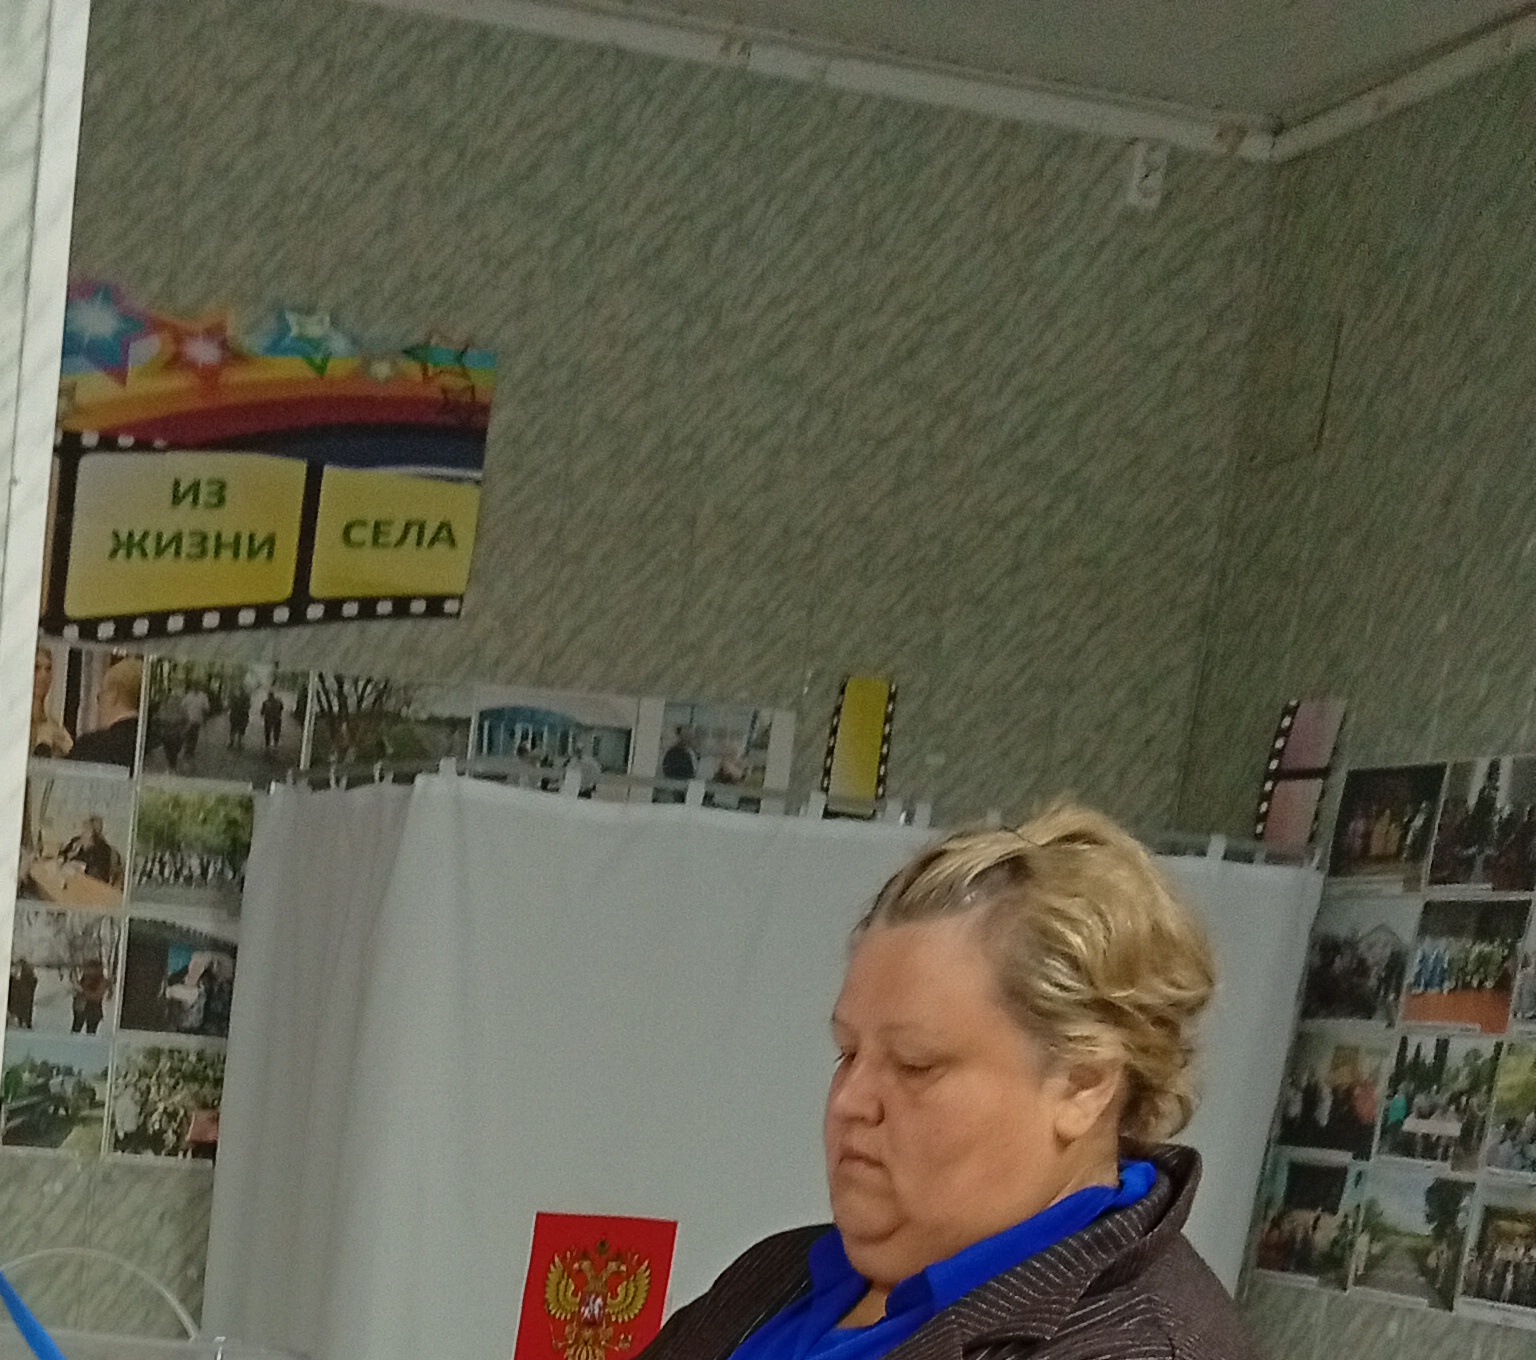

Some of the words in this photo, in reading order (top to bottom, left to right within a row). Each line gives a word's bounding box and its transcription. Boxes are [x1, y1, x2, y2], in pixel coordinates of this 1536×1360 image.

[172, 478, 227, 508] ИЗ
[108, 529, 276, 561] ЖИЗНИ
[342, 519, 458, 551] СЕЛА
